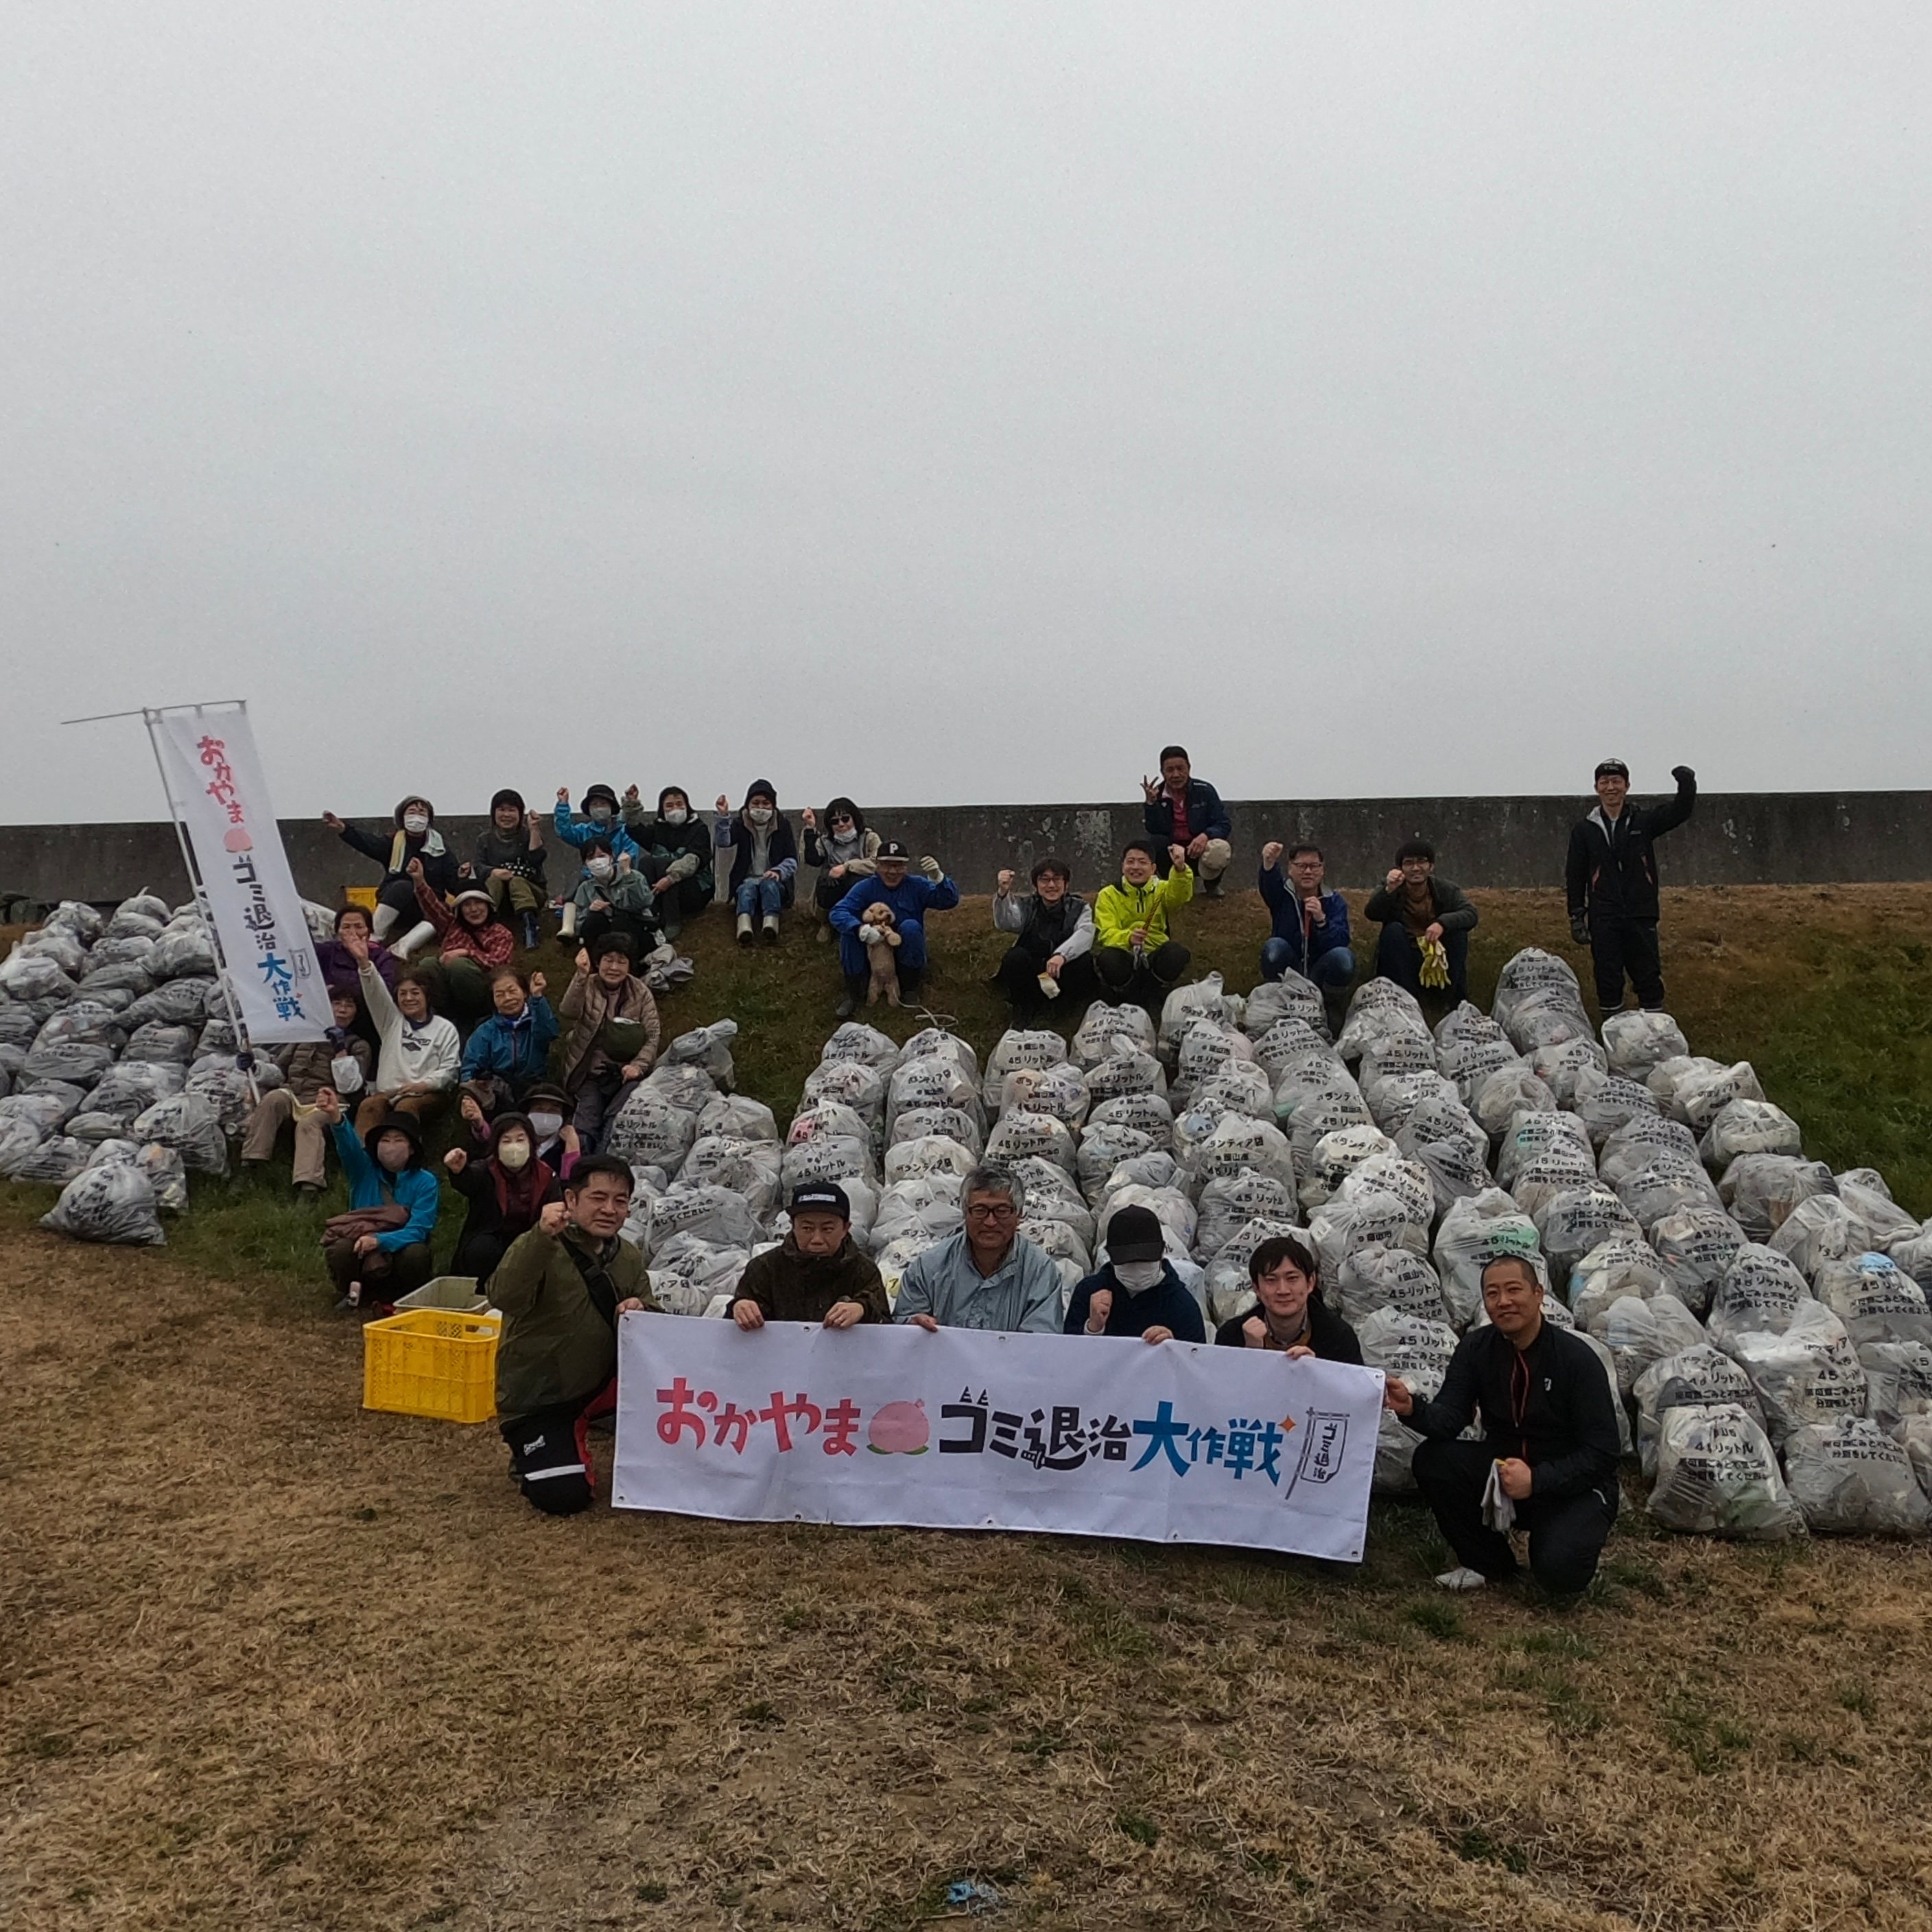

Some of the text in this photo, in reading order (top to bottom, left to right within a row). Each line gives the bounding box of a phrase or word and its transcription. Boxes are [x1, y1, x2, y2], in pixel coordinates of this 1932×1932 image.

[196, 735, 244, 823] おかやま
[890, 843, 899, 853] P
[998, 1138, 1049, 1150] 45リットル
[1403, 1167, 1426, 1186] 岡山市
[1379, 1170, 1429, 1201] 45リットル
[1236, 1194, 1283, 1205] 45リットル
[1389, 1282, 1441, 1299] 45リットル
[1398, 1336, 1456, 1349] 45リットル
[657, 1377, 861, 1456] おかやま
